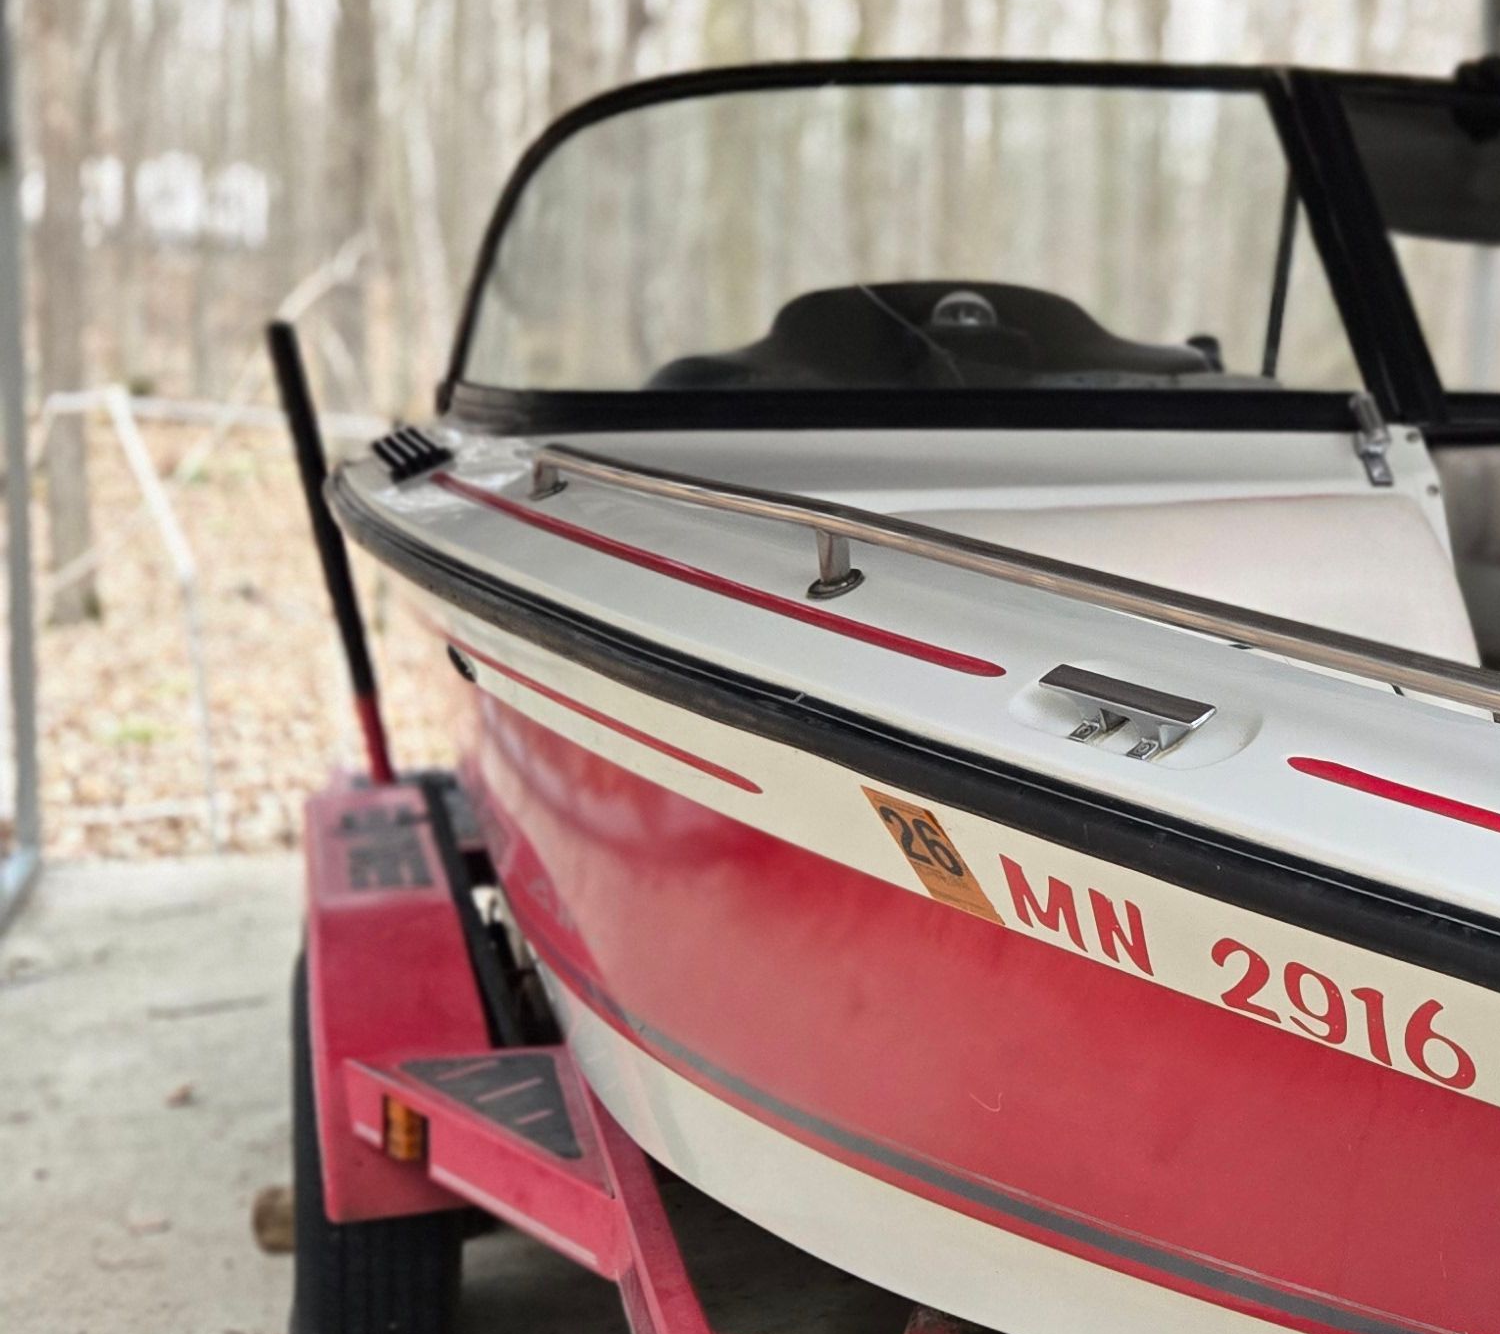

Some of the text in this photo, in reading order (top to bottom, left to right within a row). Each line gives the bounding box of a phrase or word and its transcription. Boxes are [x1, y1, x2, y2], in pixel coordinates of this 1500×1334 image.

[879, 805, 963, 877] 26
[999, 853, 1154, 977] MN
[1211, 937, 1477, 1090] 2916
